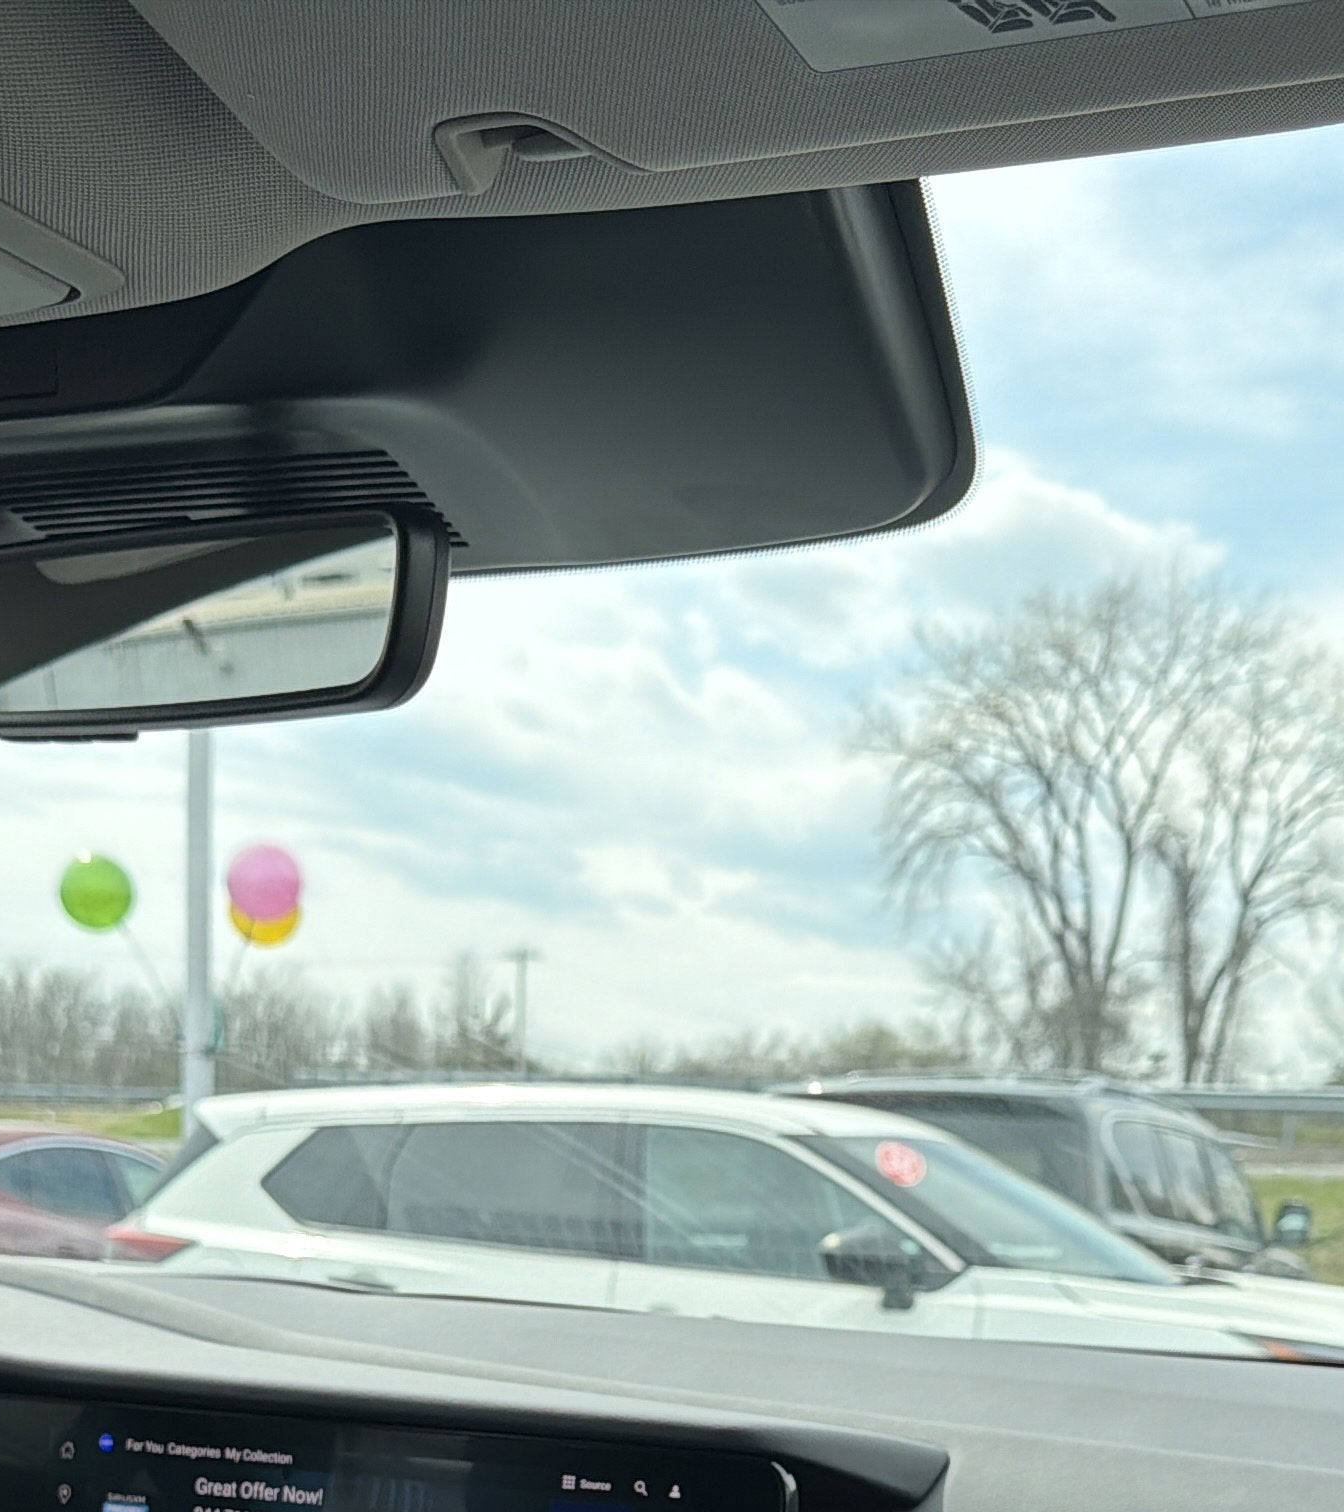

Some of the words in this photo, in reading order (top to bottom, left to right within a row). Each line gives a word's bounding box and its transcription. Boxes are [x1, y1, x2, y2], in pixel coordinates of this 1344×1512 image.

[125, 1438, 143, 1452] For
[145, 1440, 164, 1454] You
[167, 1442, 222, 1460] Categories
[224, 1446, 241, 1463] My
[242, 1448, 293, 1465] Collection
[195, 1476, 237, 1498] Great
[240, 1480, 280, 1501] Offer
[282, 1485, 324, 1507] Now!
[579, 1478, 612, 1492] Source
